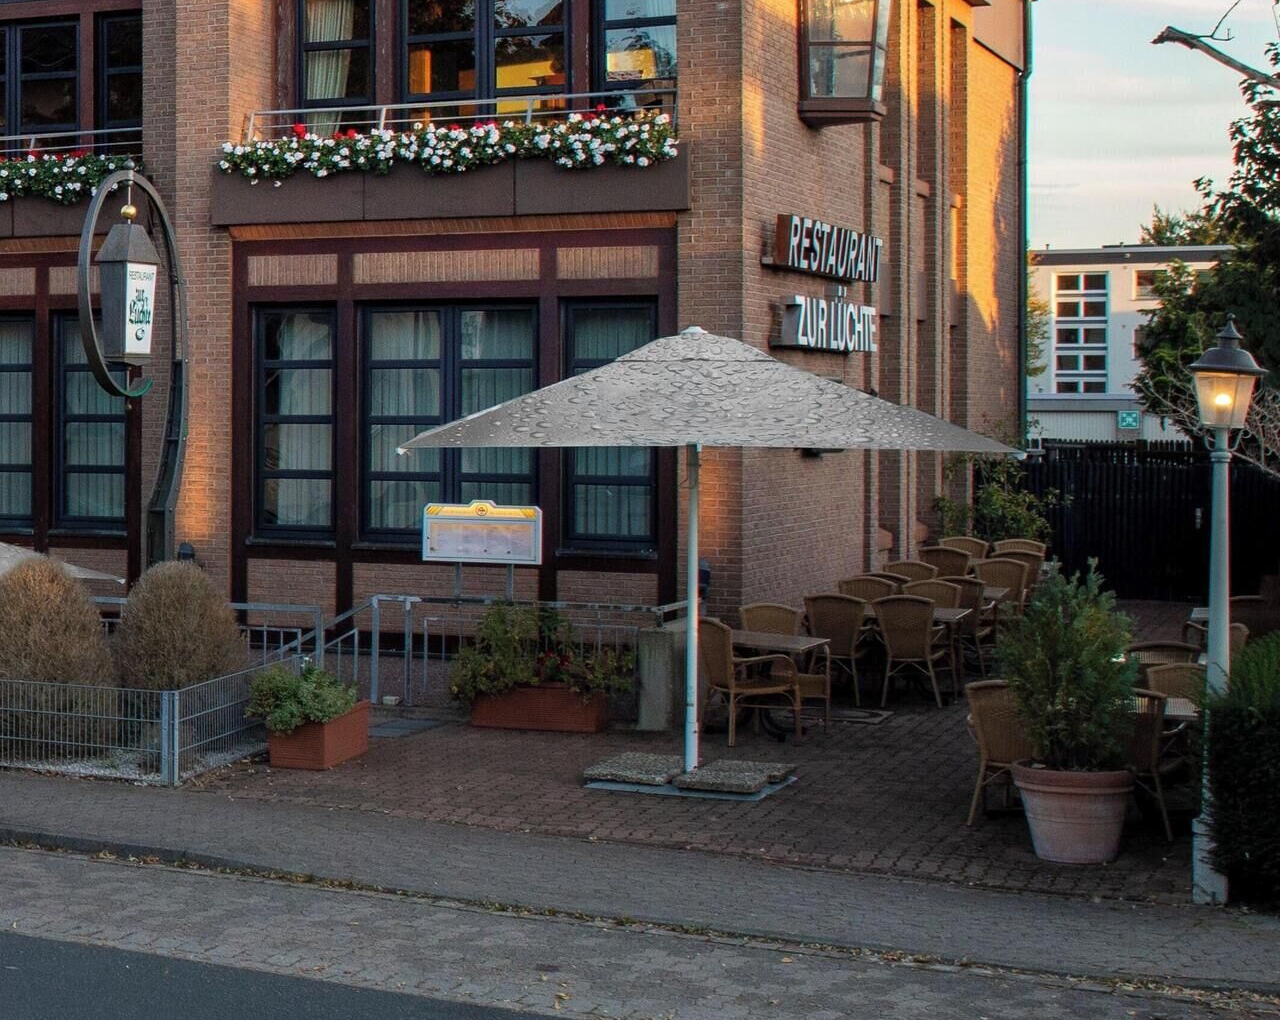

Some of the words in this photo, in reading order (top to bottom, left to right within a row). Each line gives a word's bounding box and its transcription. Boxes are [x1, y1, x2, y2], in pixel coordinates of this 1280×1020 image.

[129, 271, 154, 281] RESTAURANT
[789, 215, 883, 282] RESTAURANT
[795, 294, 828, 349] ZUR
[830, 285, 878, 352] LÜCHTE
